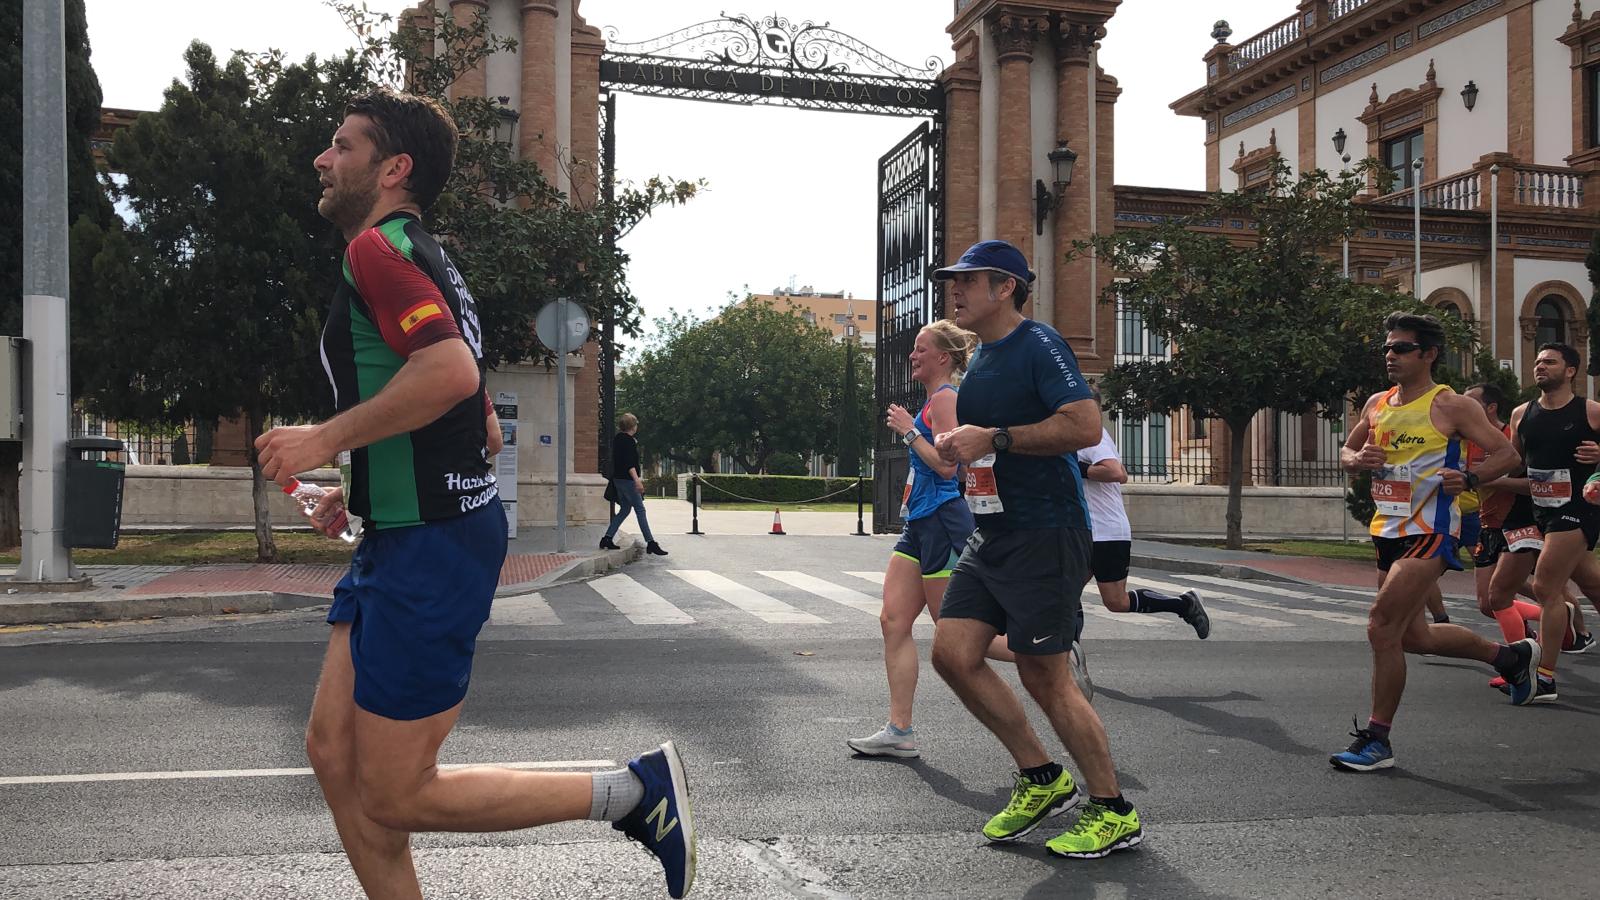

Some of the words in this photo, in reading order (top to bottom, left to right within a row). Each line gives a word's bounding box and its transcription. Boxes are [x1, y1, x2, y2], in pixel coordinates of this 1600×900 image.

[617, 62, 738, 88] FABRICA
[761, 76, 791, 93] DE
[808, 80, 929, 104] TABACOS
